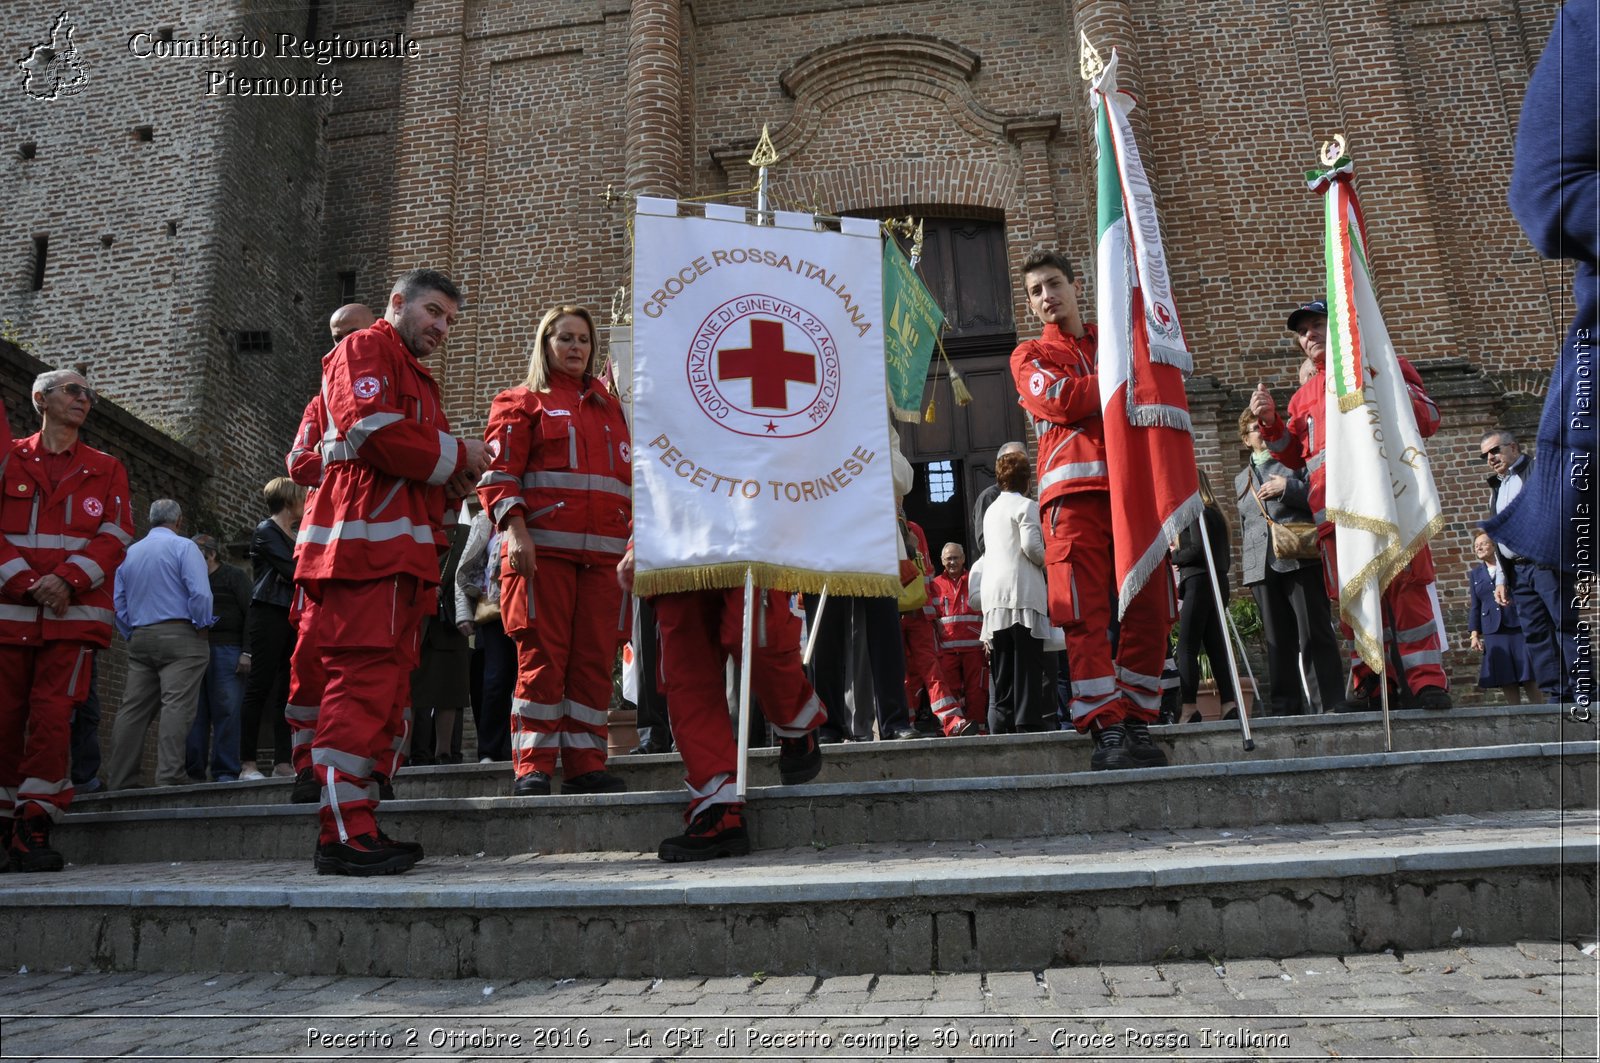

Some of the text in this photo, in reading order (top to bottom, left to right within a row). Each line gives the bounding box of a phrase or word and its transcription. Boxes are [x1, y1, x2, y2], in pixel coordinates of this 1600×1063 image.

[643, 256, 712, 319] CROCE
[712, 248, 793, 272] ROSSA
[796, 259, 872, 337] ITALIANA
[691, 299, 838, 423] CONVENZIONE DI GINEVRA 22 AGOSTO 1864
[648, 433, 761, 499] PECETTO
[768, 445, 876, 502] TORINESE
